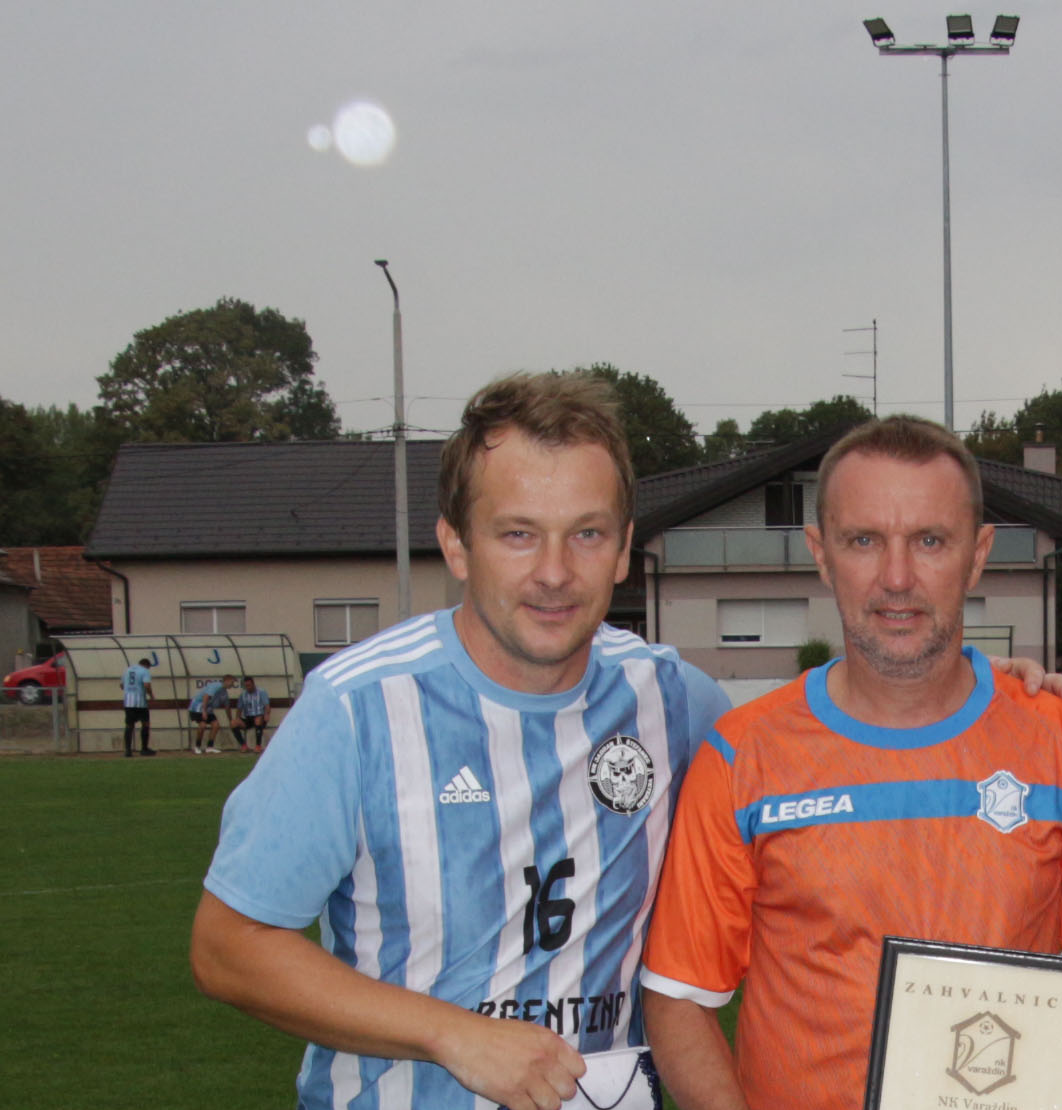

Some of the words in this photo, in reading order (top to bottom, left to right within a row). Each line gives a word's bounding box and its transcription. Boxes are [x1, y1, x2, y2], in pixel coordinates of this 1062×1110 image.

[439, 789, 491, 804] adidas
[761, 794, 854, 824] LEGEA
[523, 857, 576, 955] 16
[470, 991, 626, 1035] RGENTINA
[937, 1095, 959, 1109] NK
